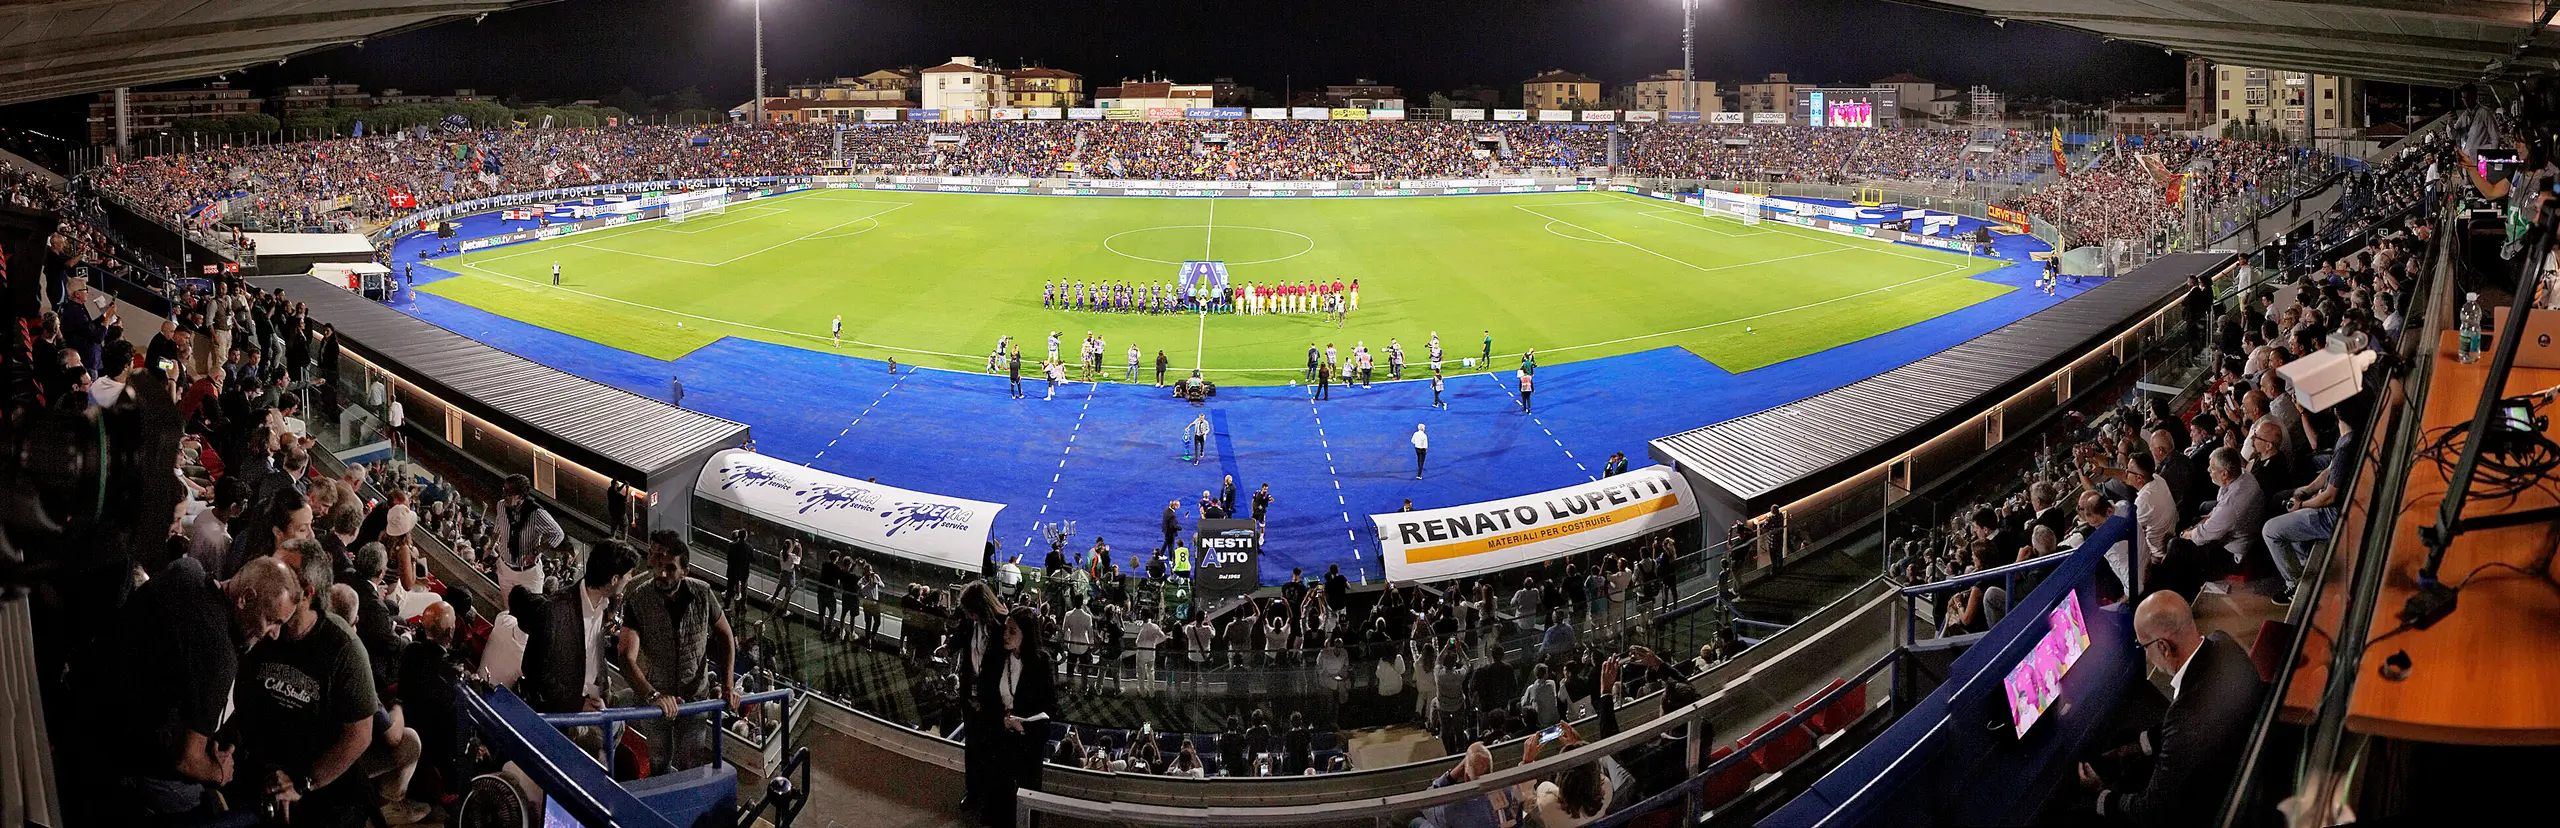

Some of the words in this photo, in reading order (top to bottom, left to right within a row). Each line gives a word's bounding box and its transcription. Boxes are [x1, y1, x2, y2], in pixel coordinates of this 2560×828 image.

[404, 215, 419, 231] PER
[420, 209, 440, 222] LORO
[443, 206, 452, 218] IN
[455, 201, 478, 214] ALTO
[480, 197, 490, 210] SI
[493, 192, 534, 208] ALZERA'
[538, 187, 558, 201] PIU'
[562, 186, 598, 199] FORTE
[602, 184, 617, 195] LA
[622, 180, 671, 193] CANZONE
[678, 180, 710, 189] DEGLI
[1988, 205, 2010, 221] CURVA
[535, 222, 583, 239] betwin360.tv
[462, 234, 511, 251] betwin360.tv
[1921, 235, 1972, 251] betwin360.tv
[767, 480, 792, 491] service
[830, 484, 882, 505] DEMA
[850, 502, 875, 513] service
[916, 503, 974, 522] DEMA
[1398, 505, 1538, 545] RENATO
[1544, 476, 1673, 520] LUPETTI
[940, 521, 969, 532] service
[1487, 532, 1538, 549] MATERIALI
[1540, 528, 1559, 540] PER
[1561, 515, 1613, 534] COSTRUIRE
[1201, 538, 1252, 548] NESTI
[1179, 551, 1187, 562] 8
[1200, 547, 1248, 568] AUTO
